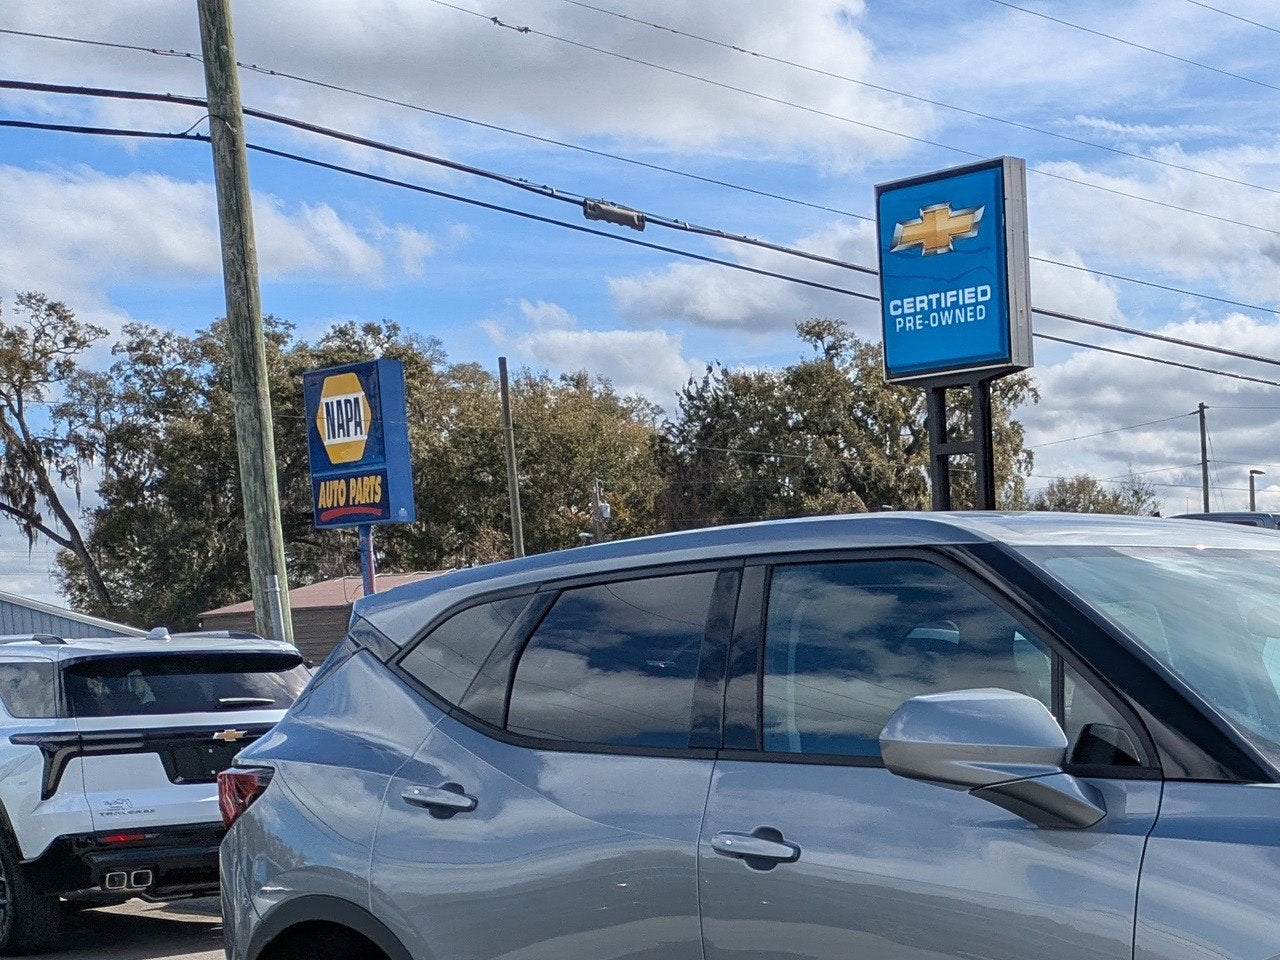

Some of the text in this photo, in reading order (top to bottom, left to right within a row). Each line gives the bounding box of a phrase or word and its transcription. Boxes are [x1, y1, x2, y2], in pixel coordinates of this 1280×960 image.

[889, 284, 992, 316] CERTIFIED
[895, 304, 986, 333] PRE-OWNED
[324, 396, 364, 440] NAPA
[318, 475, 382, 509] AUTO PARTS
